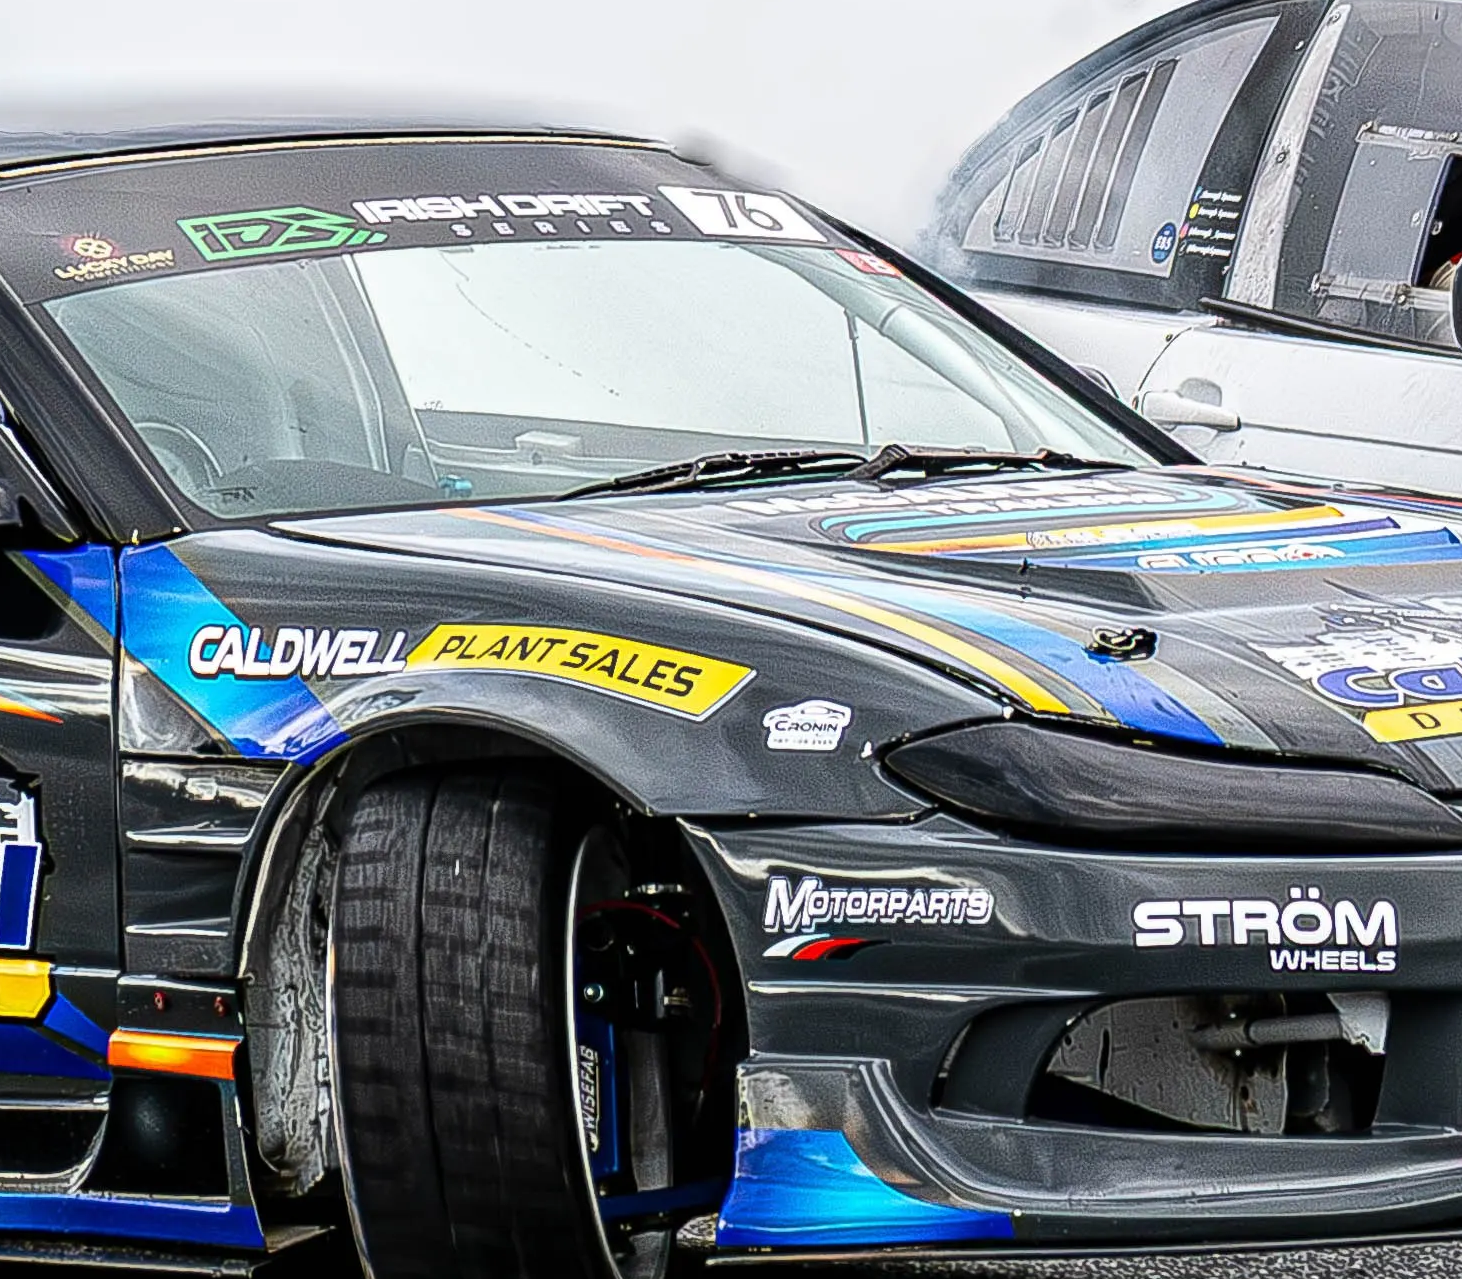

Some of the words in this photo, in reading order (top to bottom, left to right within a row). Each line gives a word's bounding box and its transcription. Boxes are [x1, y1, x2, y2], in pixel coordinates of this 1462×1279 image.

[352, 194, 496, 223] IRISH
[496, 193, 653, 218] DRIFT
[691, 191, 784, 231] 76
[450, 219, 673, 237] SERIES
[54, 256, 127, 279] LUCKY
[128, 249, 175, 265] DAY
[188, 625, 408, 678] CALDWELL
[435, 633, 562, 664] PLANT
[562, 646, 703, 698] SALES
[775, 720, 838, 732] CRONIN
[1133, 886, 1399, 948] STRÖM
[1269, 949, 1398, 972] WHEELS
